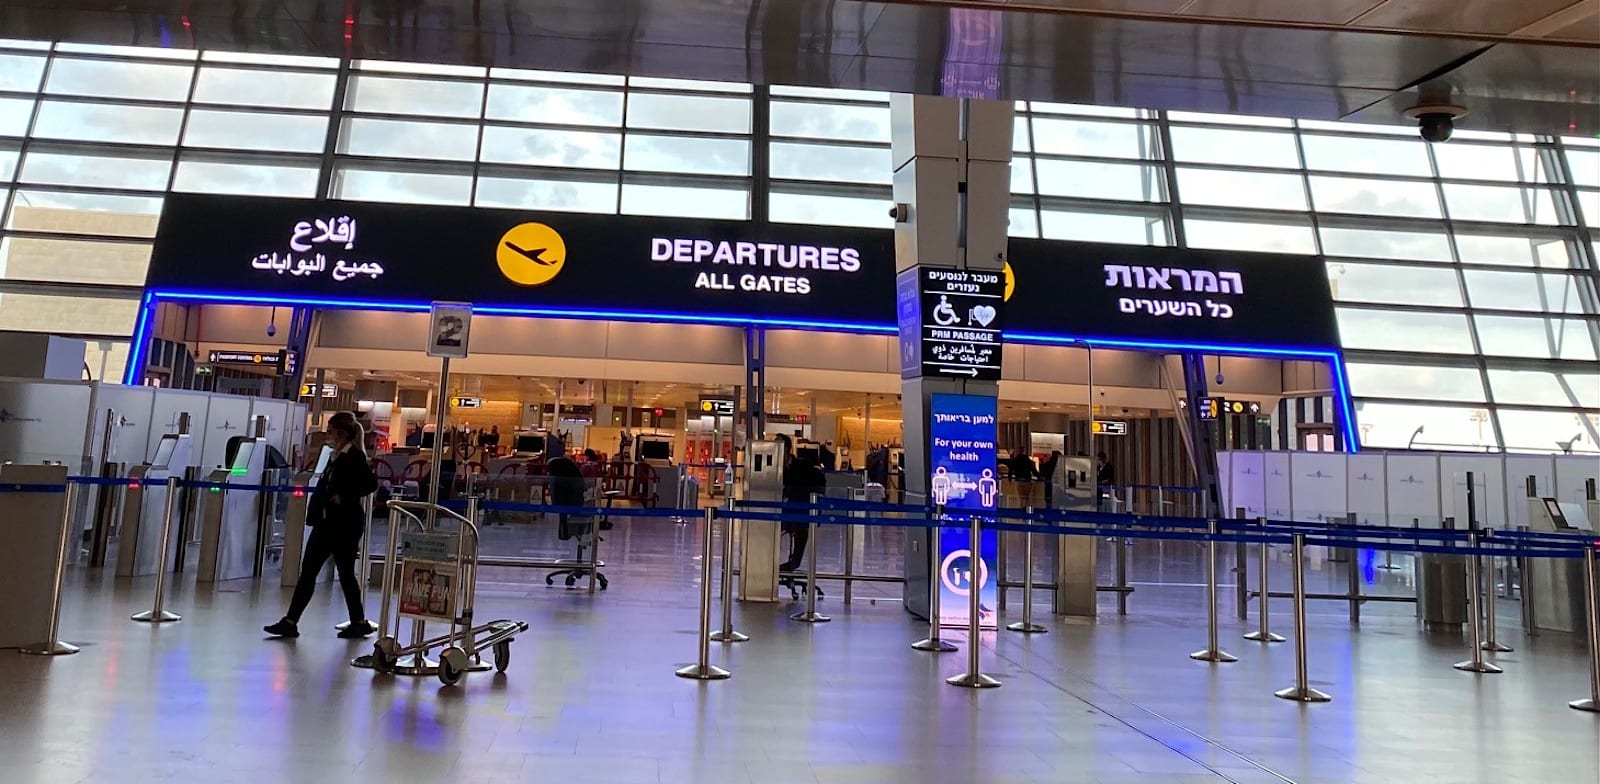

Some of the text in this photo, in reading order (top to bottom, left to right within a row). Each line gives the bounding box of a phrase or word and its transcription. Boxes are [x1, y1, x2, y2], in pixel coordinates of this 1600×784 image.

[290, 215, 356, 252] إقلاع
[651, 238, 861, 272] DEPARTURES
[251, 251, 384, 281] جميع البوابات
[695, 272, 811, 294] ALL GATES
[929, 271, 999, 284] מעבר לנוסעים
[946, 282, 981, 293] נעזרים
[1103, 264, 1244, 294] המראות
[1118, 297, 1234, 318] כל השערים
[436, 315, 463, 347] 2
[931, 329, 994, 342] PRM PASSAGE
[934, 413, 994, 425] למען בריאותך
[934, 437, 994, 449] For your own
[949, 451, 979, 461] health
